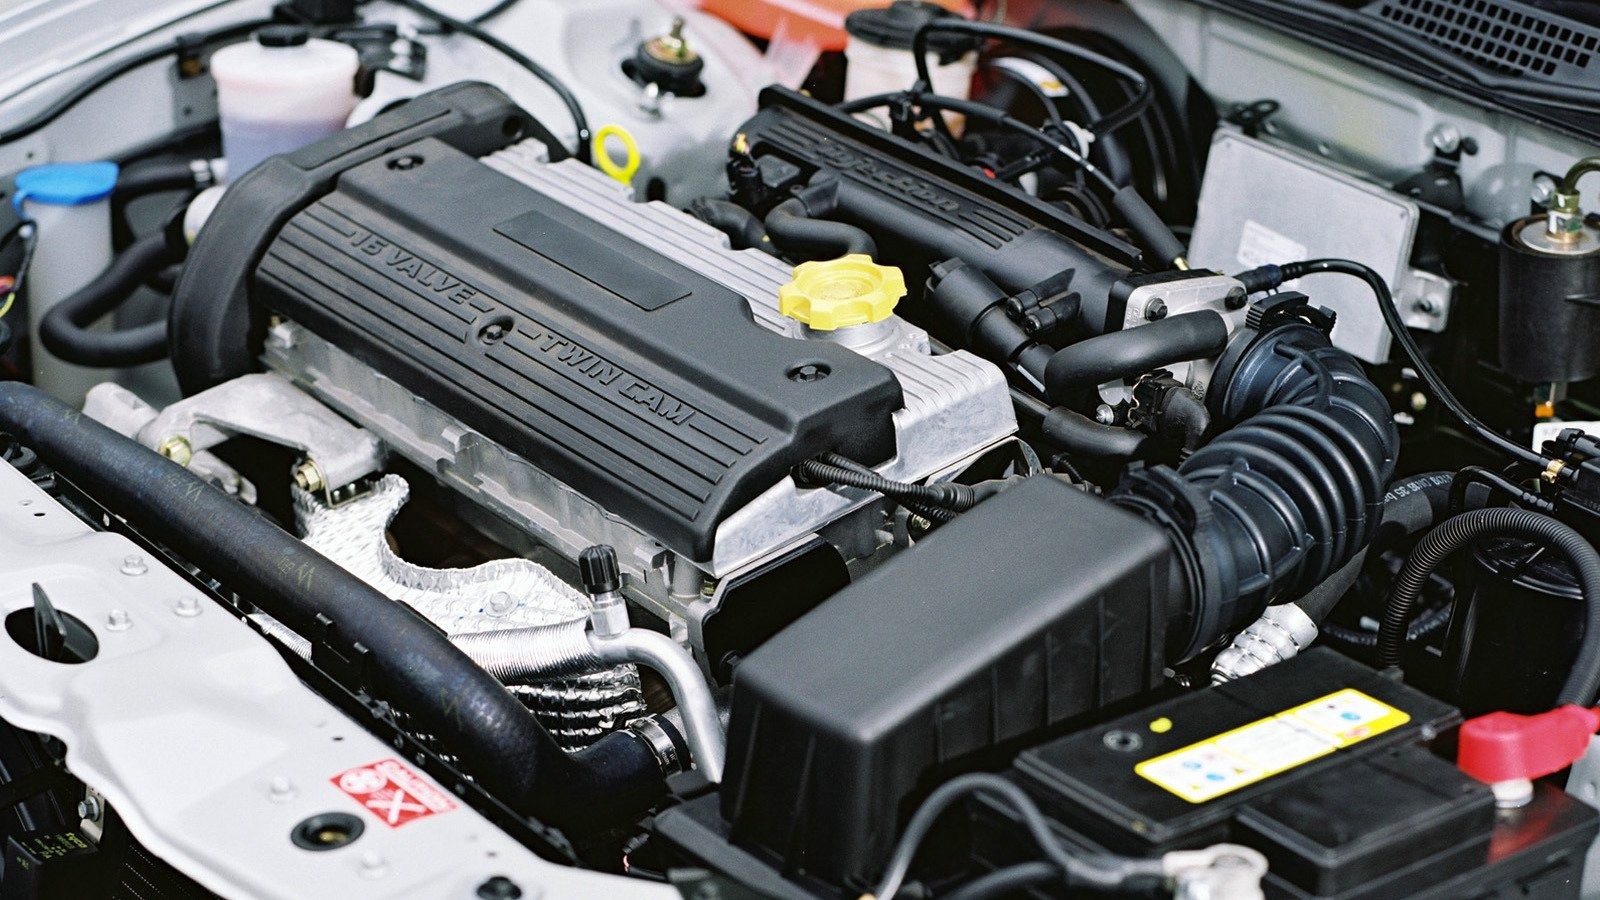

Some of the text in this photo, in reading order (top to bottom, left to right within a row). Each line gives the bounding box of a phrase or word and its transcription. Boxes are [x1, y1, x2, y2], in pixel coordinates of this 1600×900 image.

[351, 229, 475, 304] 16 VALVE
[540, 334, 693, 426] TWIN CAM
[1394, 486, 1410, 498] 35
